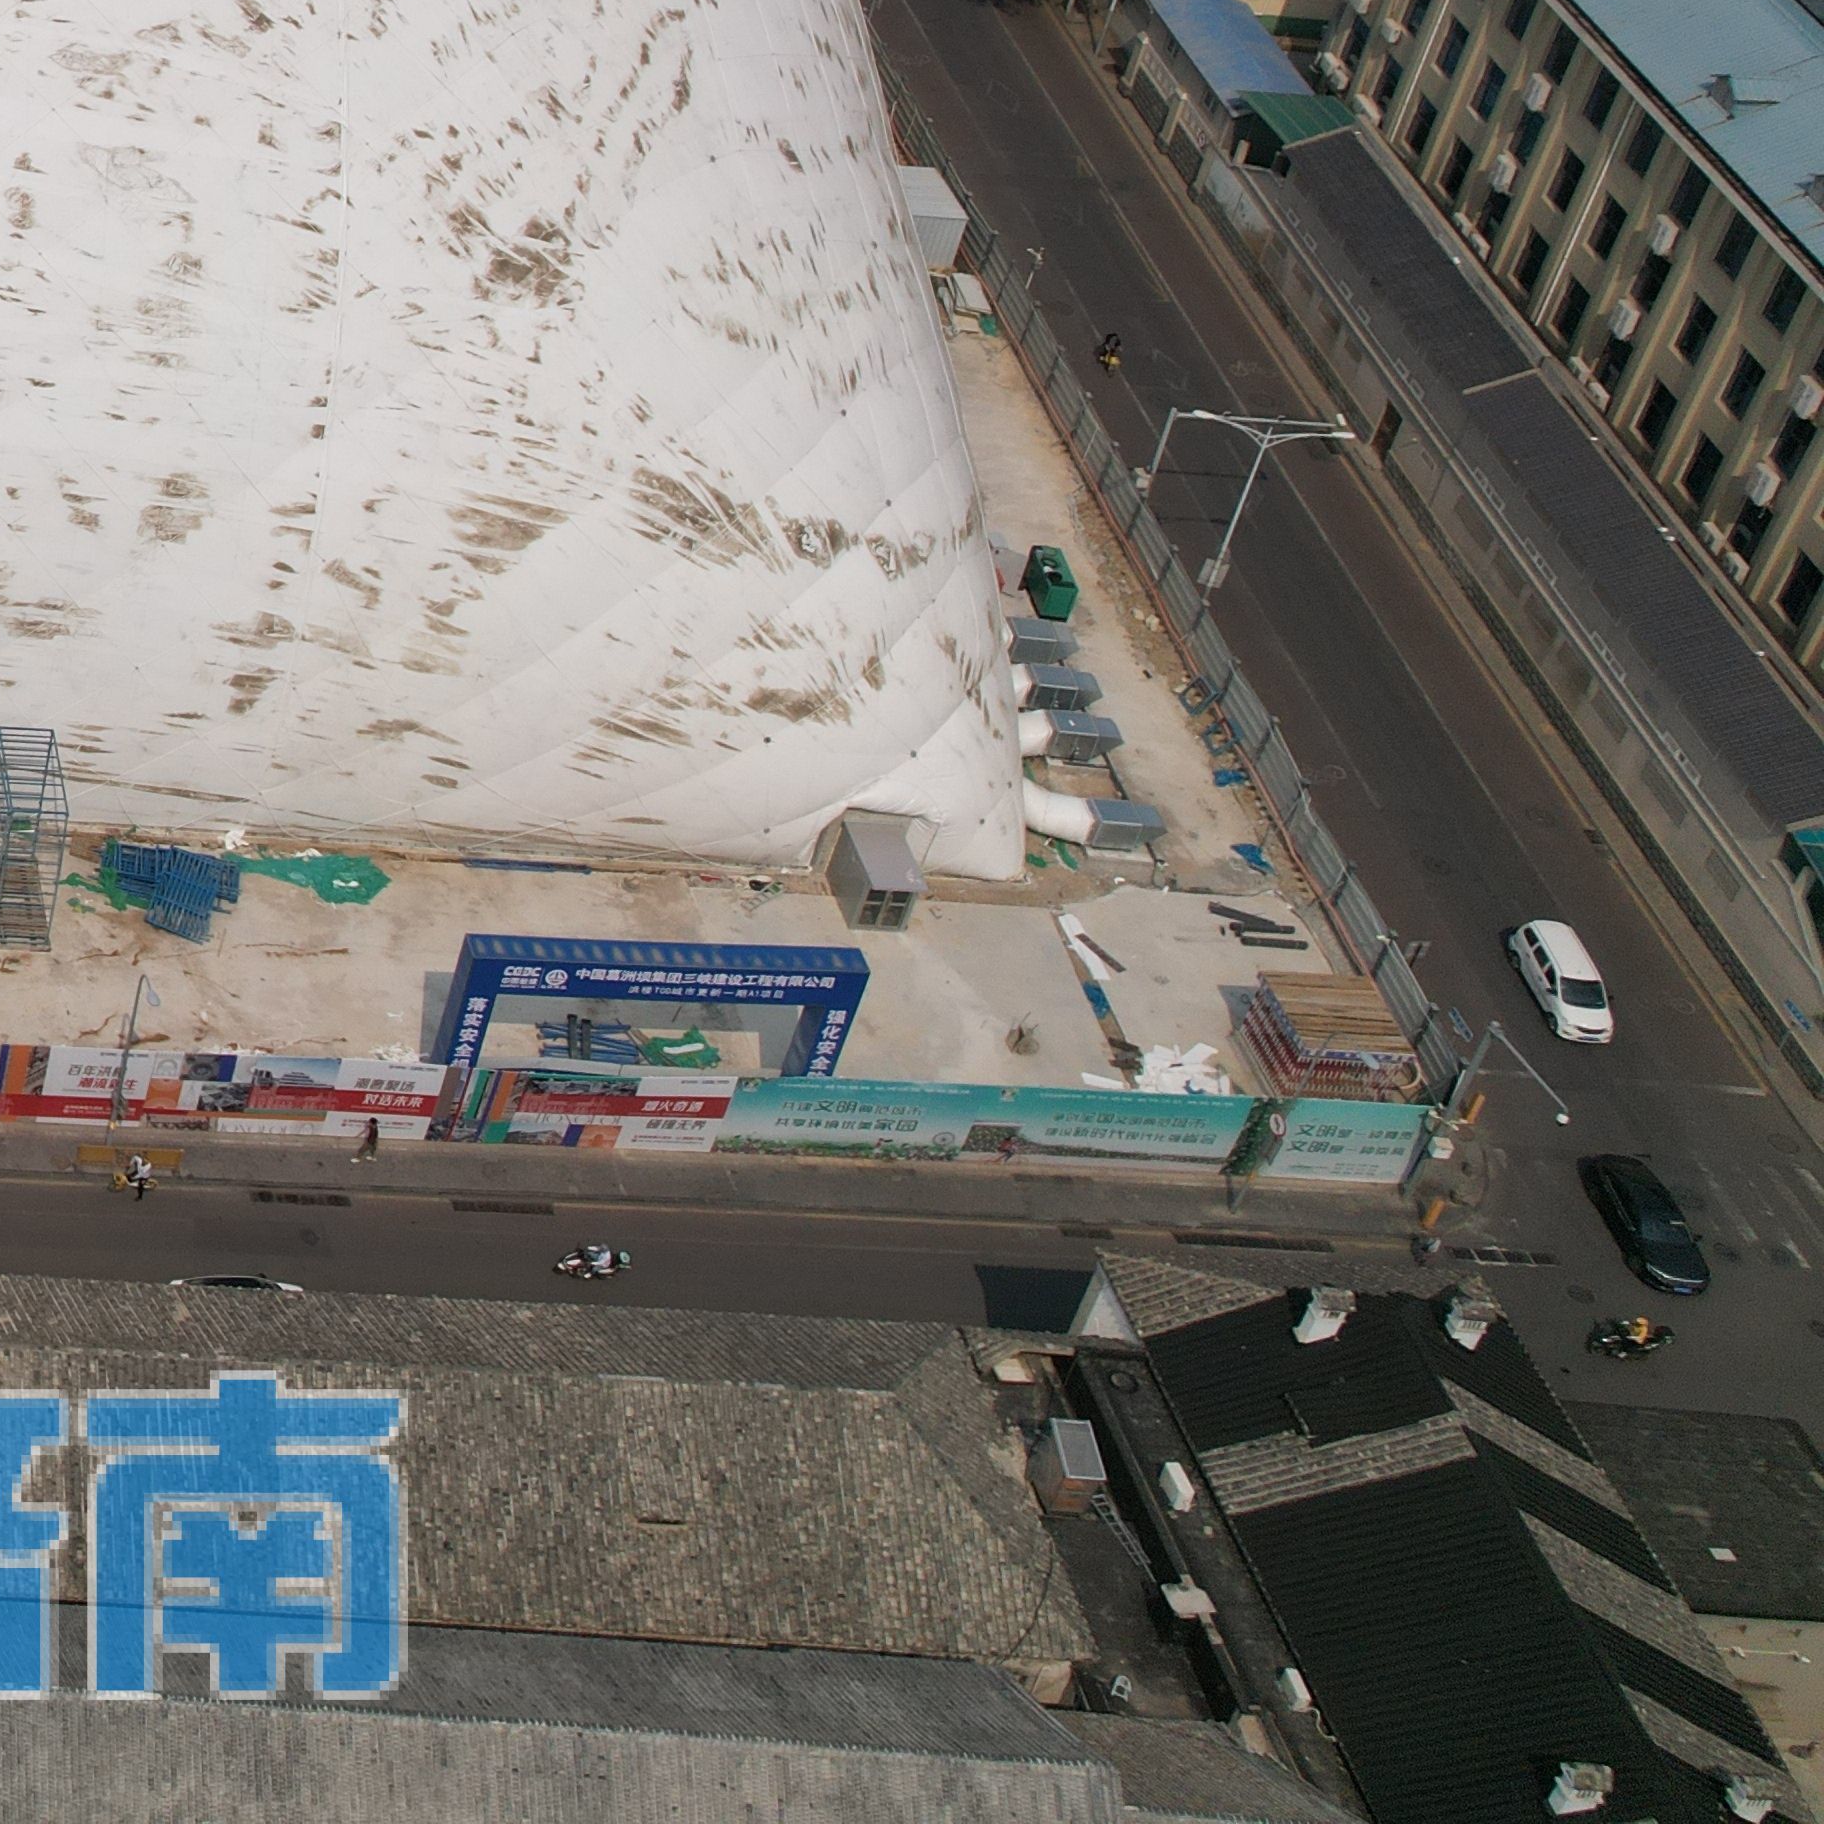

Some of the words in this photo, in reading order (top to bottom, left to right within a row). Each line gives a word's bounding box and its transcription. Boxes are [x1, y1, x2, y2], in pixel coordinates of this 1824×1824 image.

[575, 968, 835, 988] 中国葛洲坝集团三峡建设工程有限公司
[362, 1093, 425, 1108] 对话未来
